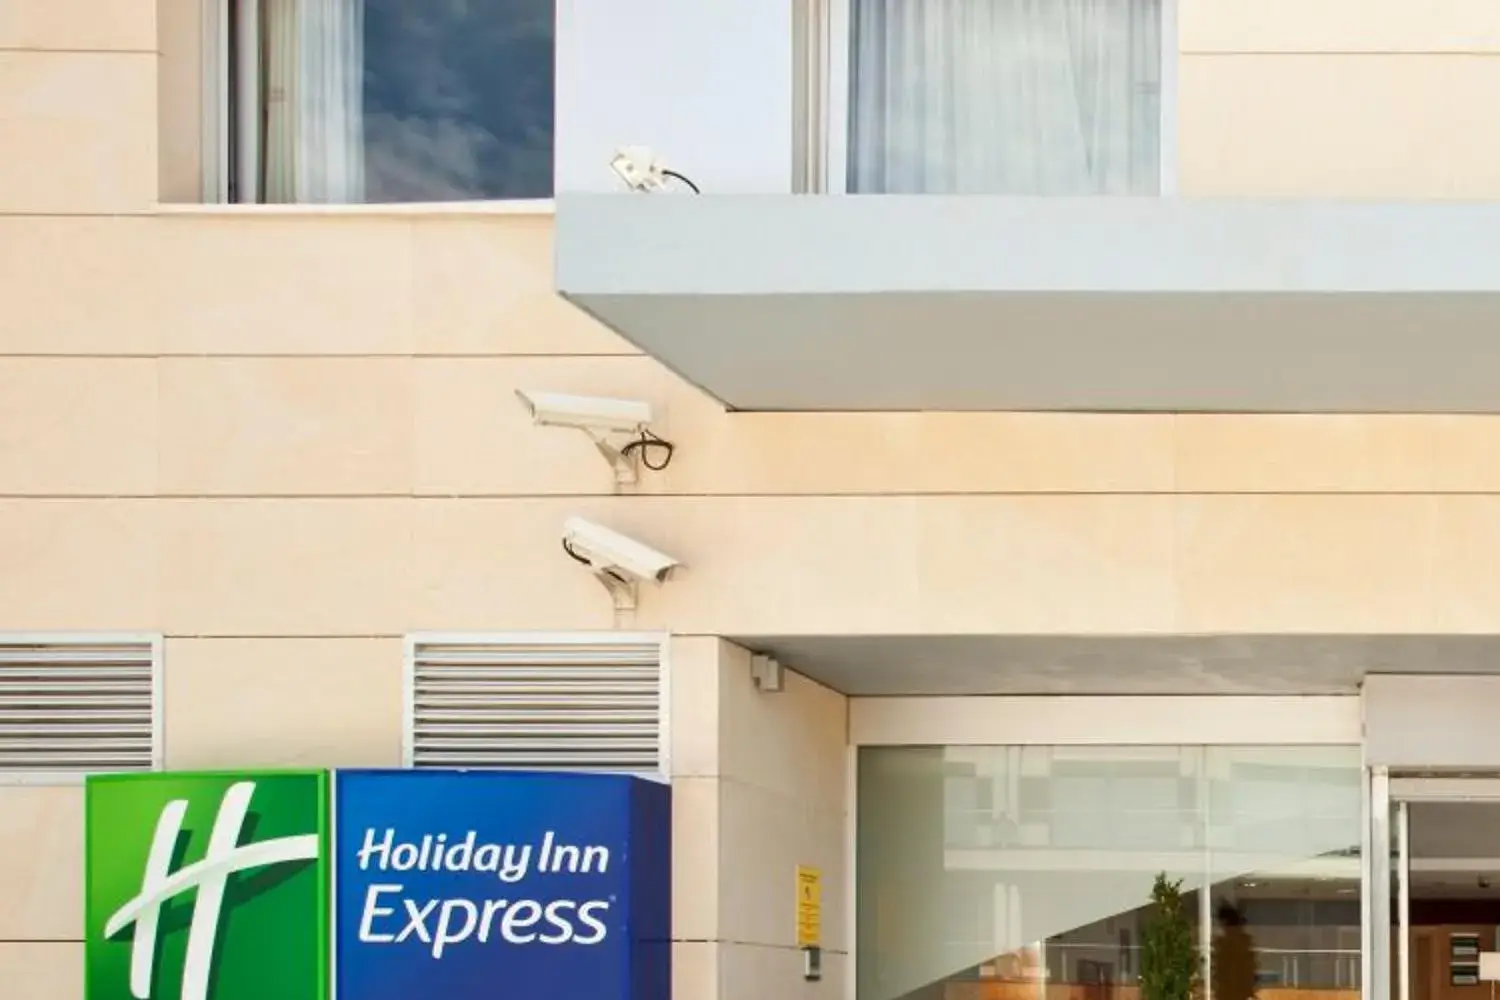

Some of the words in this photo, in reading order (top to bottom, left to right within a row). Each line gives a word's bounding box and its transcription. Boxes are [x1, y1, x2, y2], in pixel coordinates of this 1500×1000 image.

[357, 828, 531, 882] Holiday
[538, 831, 609, 873] Inn
[359, 884, 609, 959] Express
